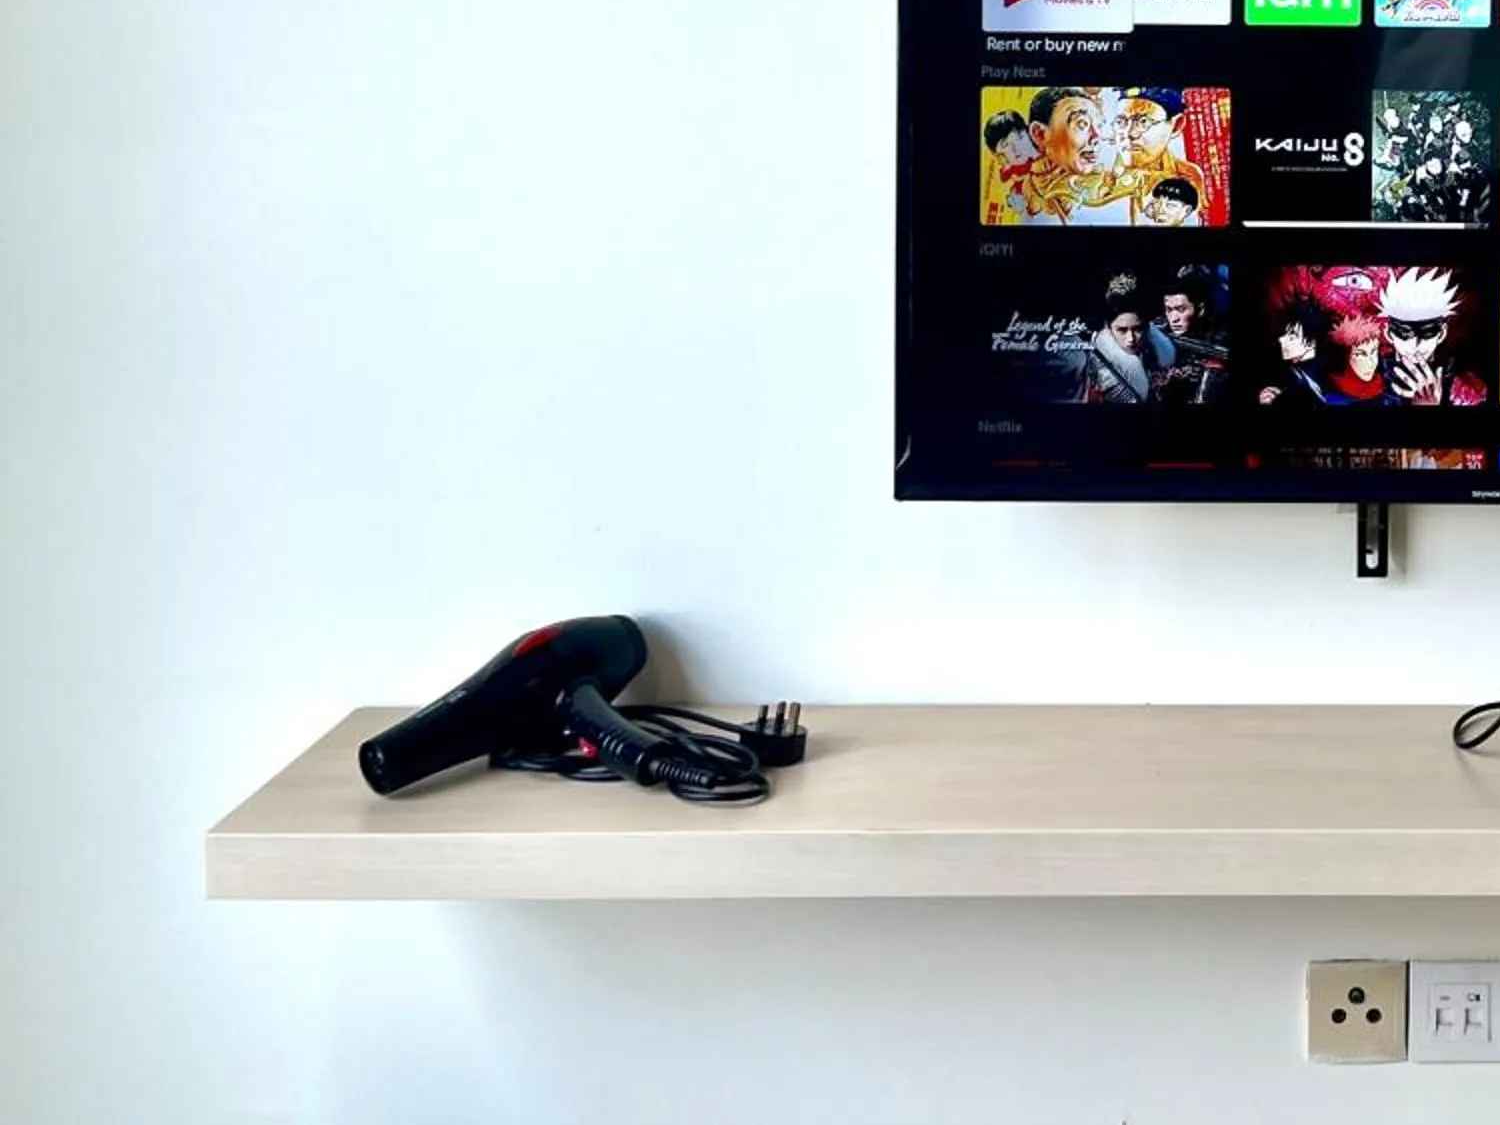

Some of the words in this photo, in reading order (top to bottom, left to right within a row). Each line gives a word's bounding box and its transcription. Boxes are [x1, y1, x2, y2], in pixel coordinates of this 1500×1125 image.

[986, 36, 1021, 52] Rent
[1024, 40, 1042, 52] or
[1045, 37, 1074, 55] buy
[1077, 40, 1109, 52] new
[981, 65, 1010, 79] Play
[1013, 65, 1046, 78] Next
[1255, 138, 1338, 152] KAIJU
[1343, 132, 1365, 166] 8
[1007, 310, 1053, 339] Legend
